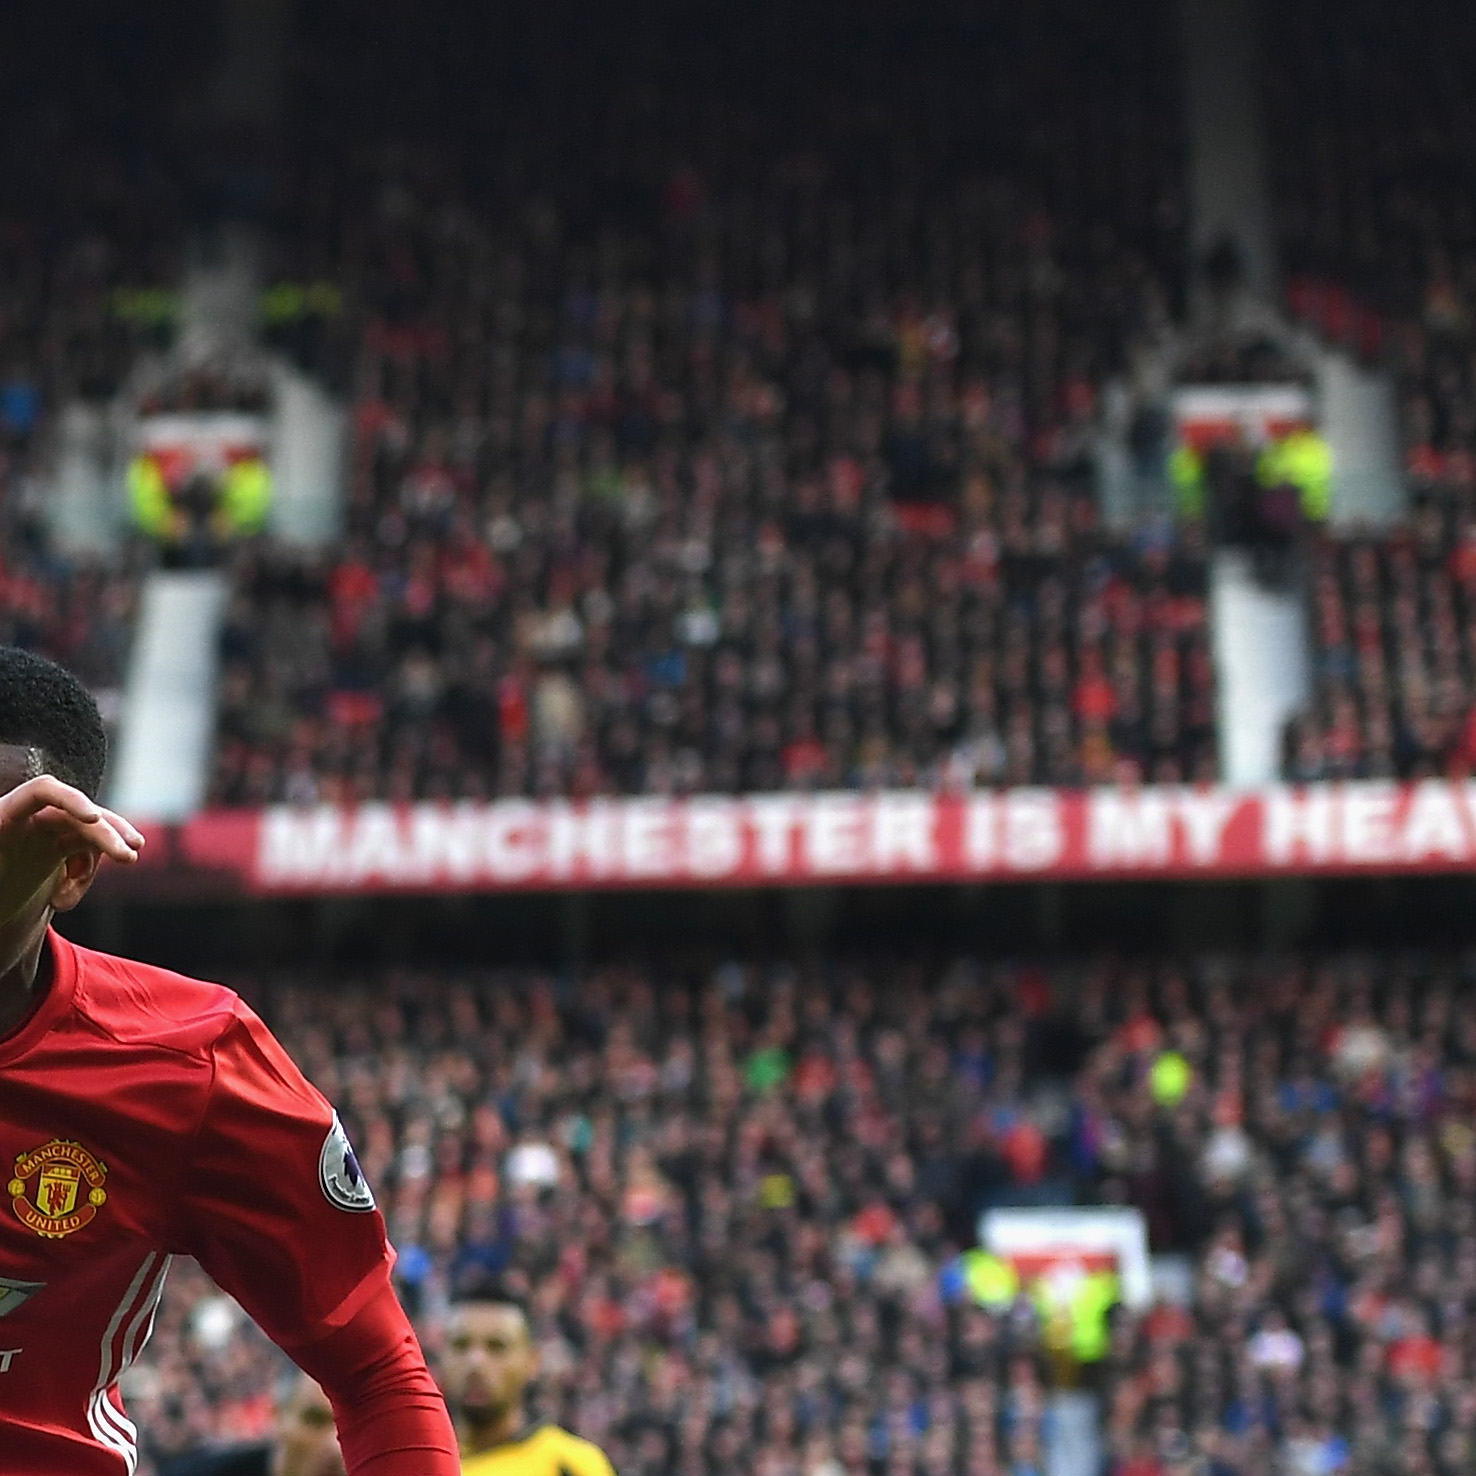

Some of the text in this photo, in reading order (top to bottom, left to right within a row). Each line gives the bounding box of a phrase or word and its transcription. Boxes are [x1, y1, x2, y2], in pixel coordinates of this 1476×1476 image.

[259, 778, 1476, 885] MANCHESTER IS MY HEA
[22, 1146, 99, 1181] MANCHESTER
[26, 1211, 80, 1231] UNITED
